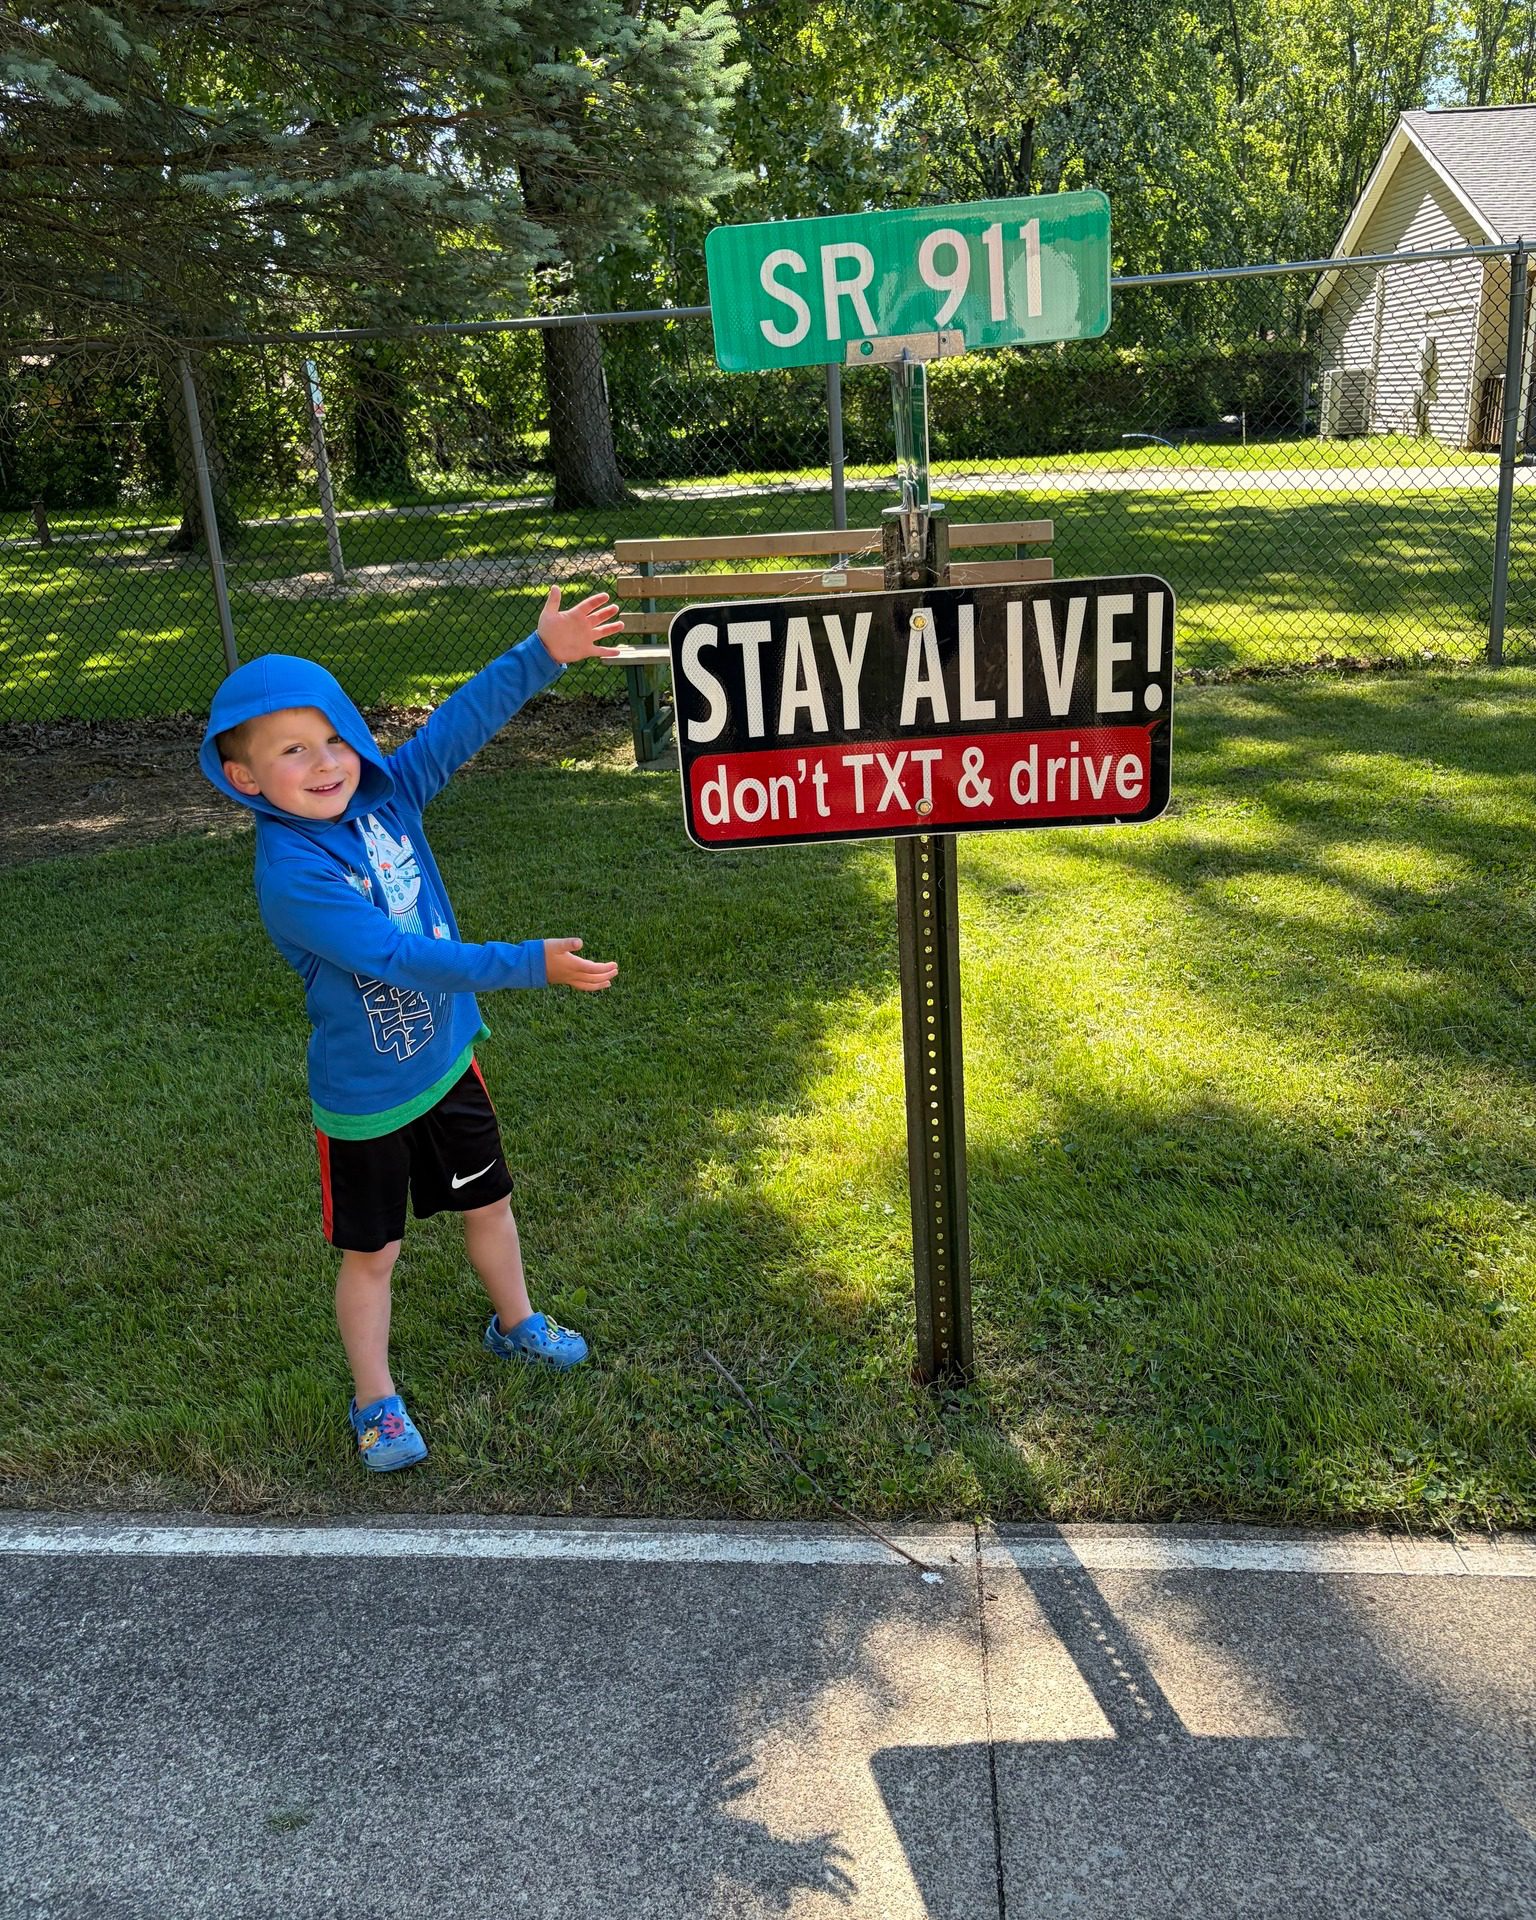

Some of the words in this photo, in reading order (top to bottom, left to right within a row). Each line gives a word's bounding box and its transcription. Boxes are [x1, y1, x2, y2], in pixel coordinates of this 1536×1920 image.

[759, 242, 879, 348] SR
[918, 217, 1042, 327] 911
[680, 611, 873, 743] STAY
[899, 591, 1165, 726] ALIVE!
[699, 758, 831, 826] don't
[842, 748, 943, 814] TXT
[957, 745, 995, 808] &
[1008, 740, 1144, 806] drive
